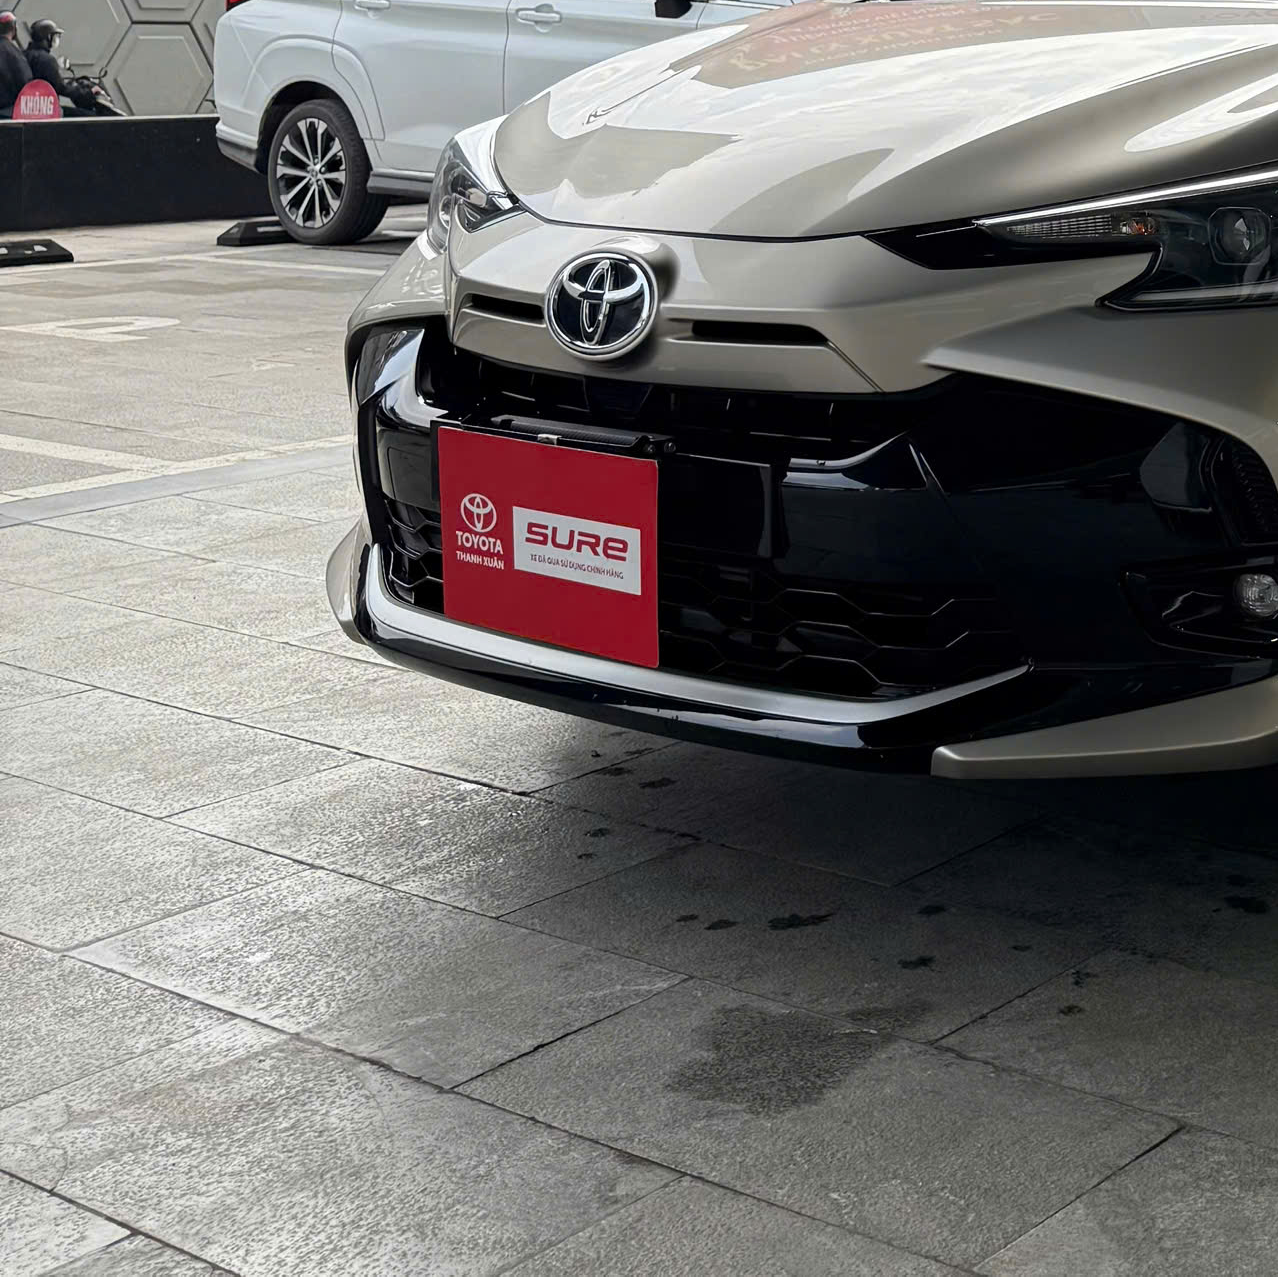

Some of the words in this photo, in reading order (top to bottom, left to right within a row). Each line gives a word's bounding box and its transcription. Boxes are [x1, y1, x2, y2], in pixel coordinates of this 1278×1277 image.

[455, 530, 503, 555] TOYOTA
[456, 550, 482, 565] THANH
[483, 556, 504, 570] XUÂN
